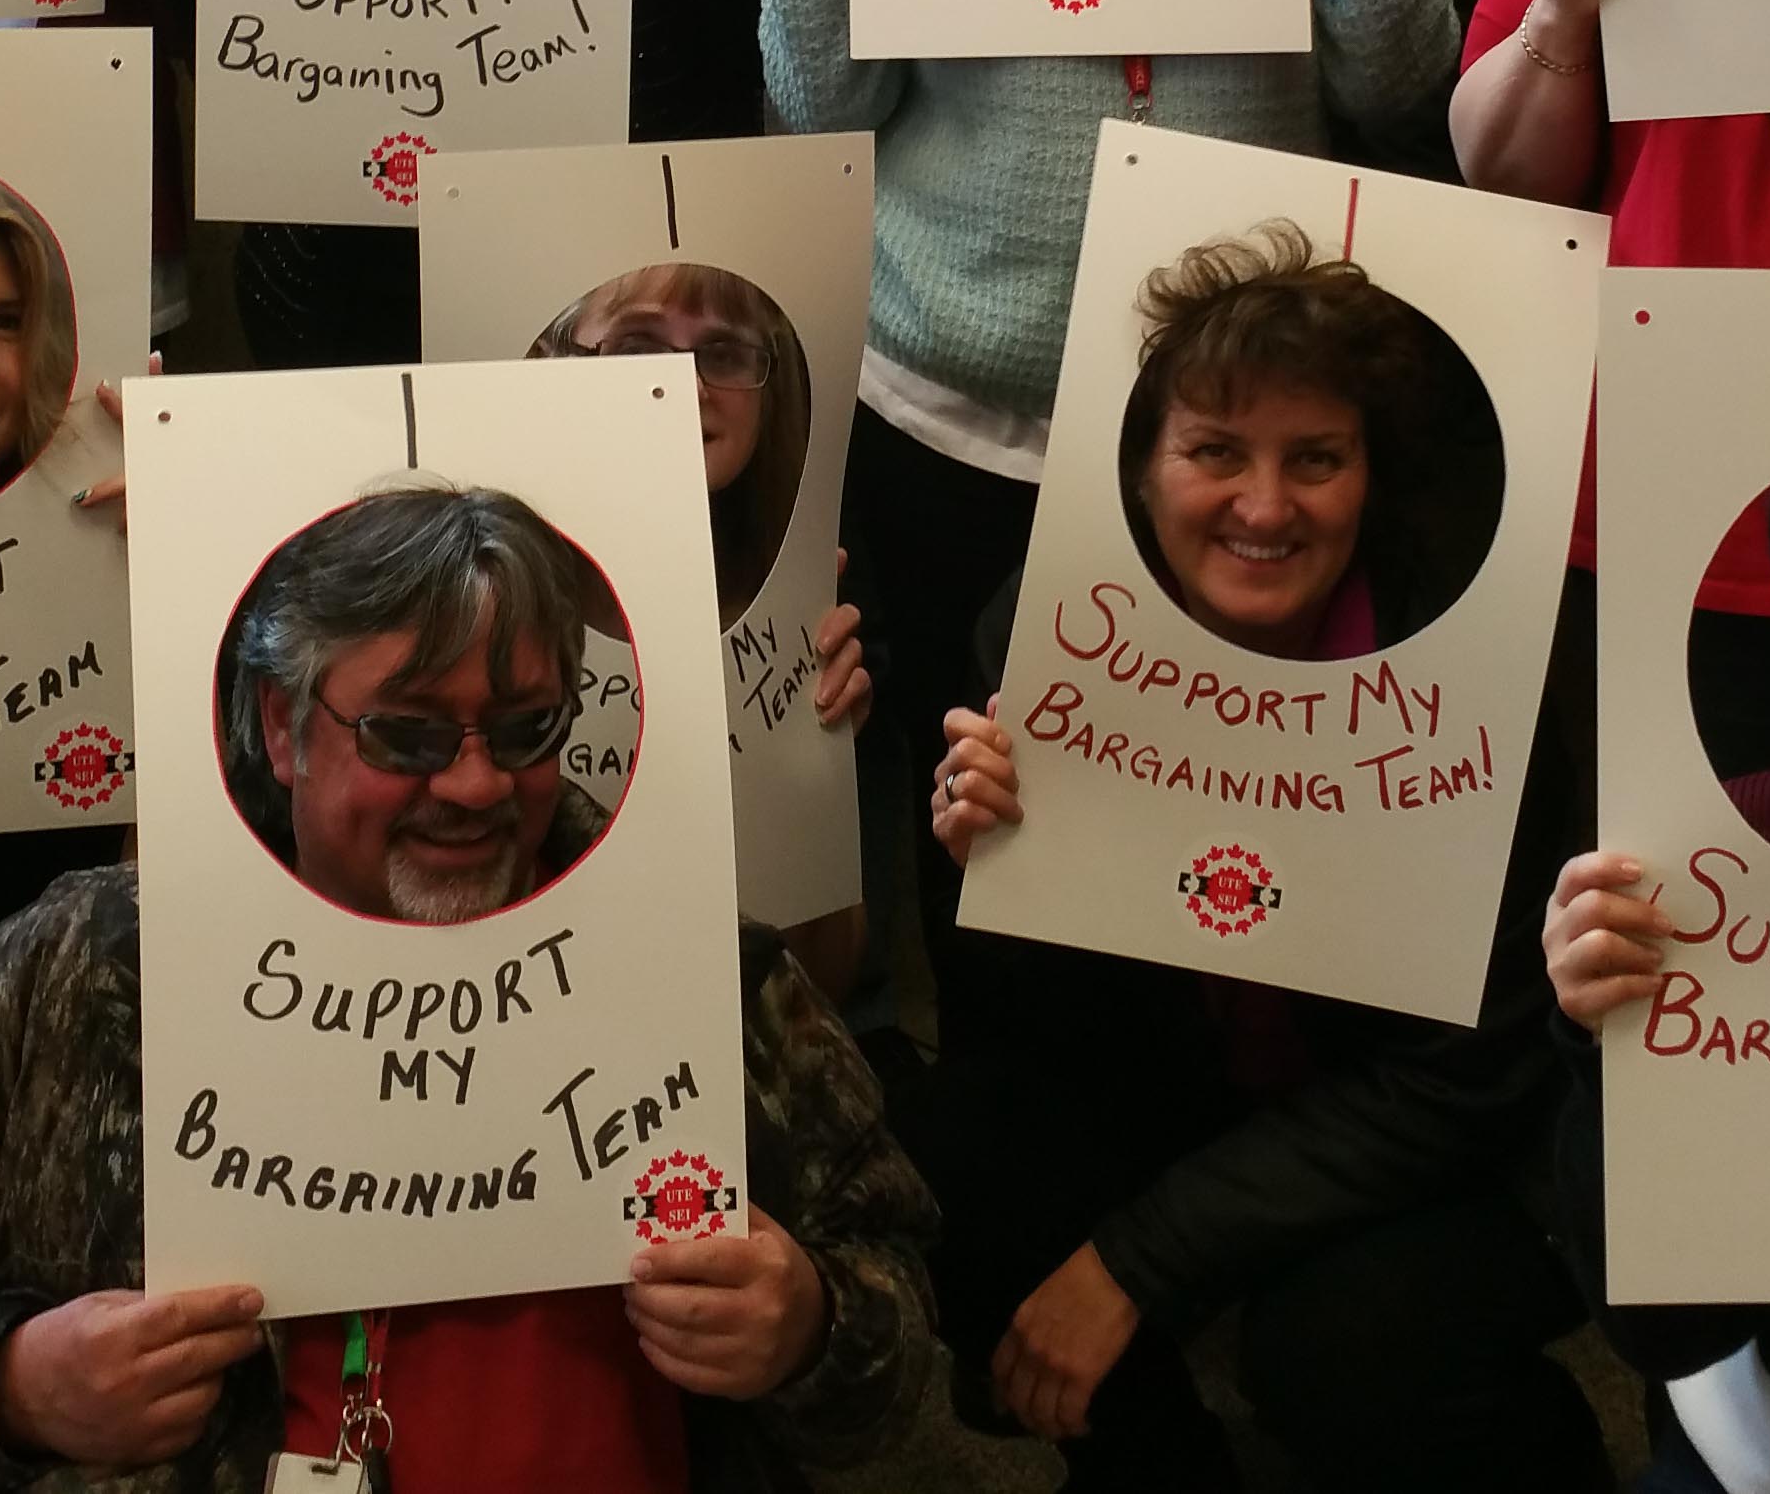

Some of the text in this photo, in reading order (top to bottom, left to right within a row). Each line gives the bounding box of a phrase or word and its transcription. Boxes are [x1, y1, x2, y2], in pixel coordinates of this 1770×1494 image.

[217, 14, 445, 118] Bargaining
[742, 625, 817, 731] TEAM!
[1054, 582, 1327, 736] SUPPORT
[1024, 681, 1493, 813] BARGAINING TEAM!
[1216, 894, 1238, 907] SEI
[1218, 877, 1243, 891] UTE
[242, 929, 574, 1040] SUPPORT
[379, 1046, 476, 1105] MY
[174, 1061, 701, 1218] BARGAINING TEAM
[665, 1188, 693, 1204] UTE
[668, 1209, 692, 1223] SEI
